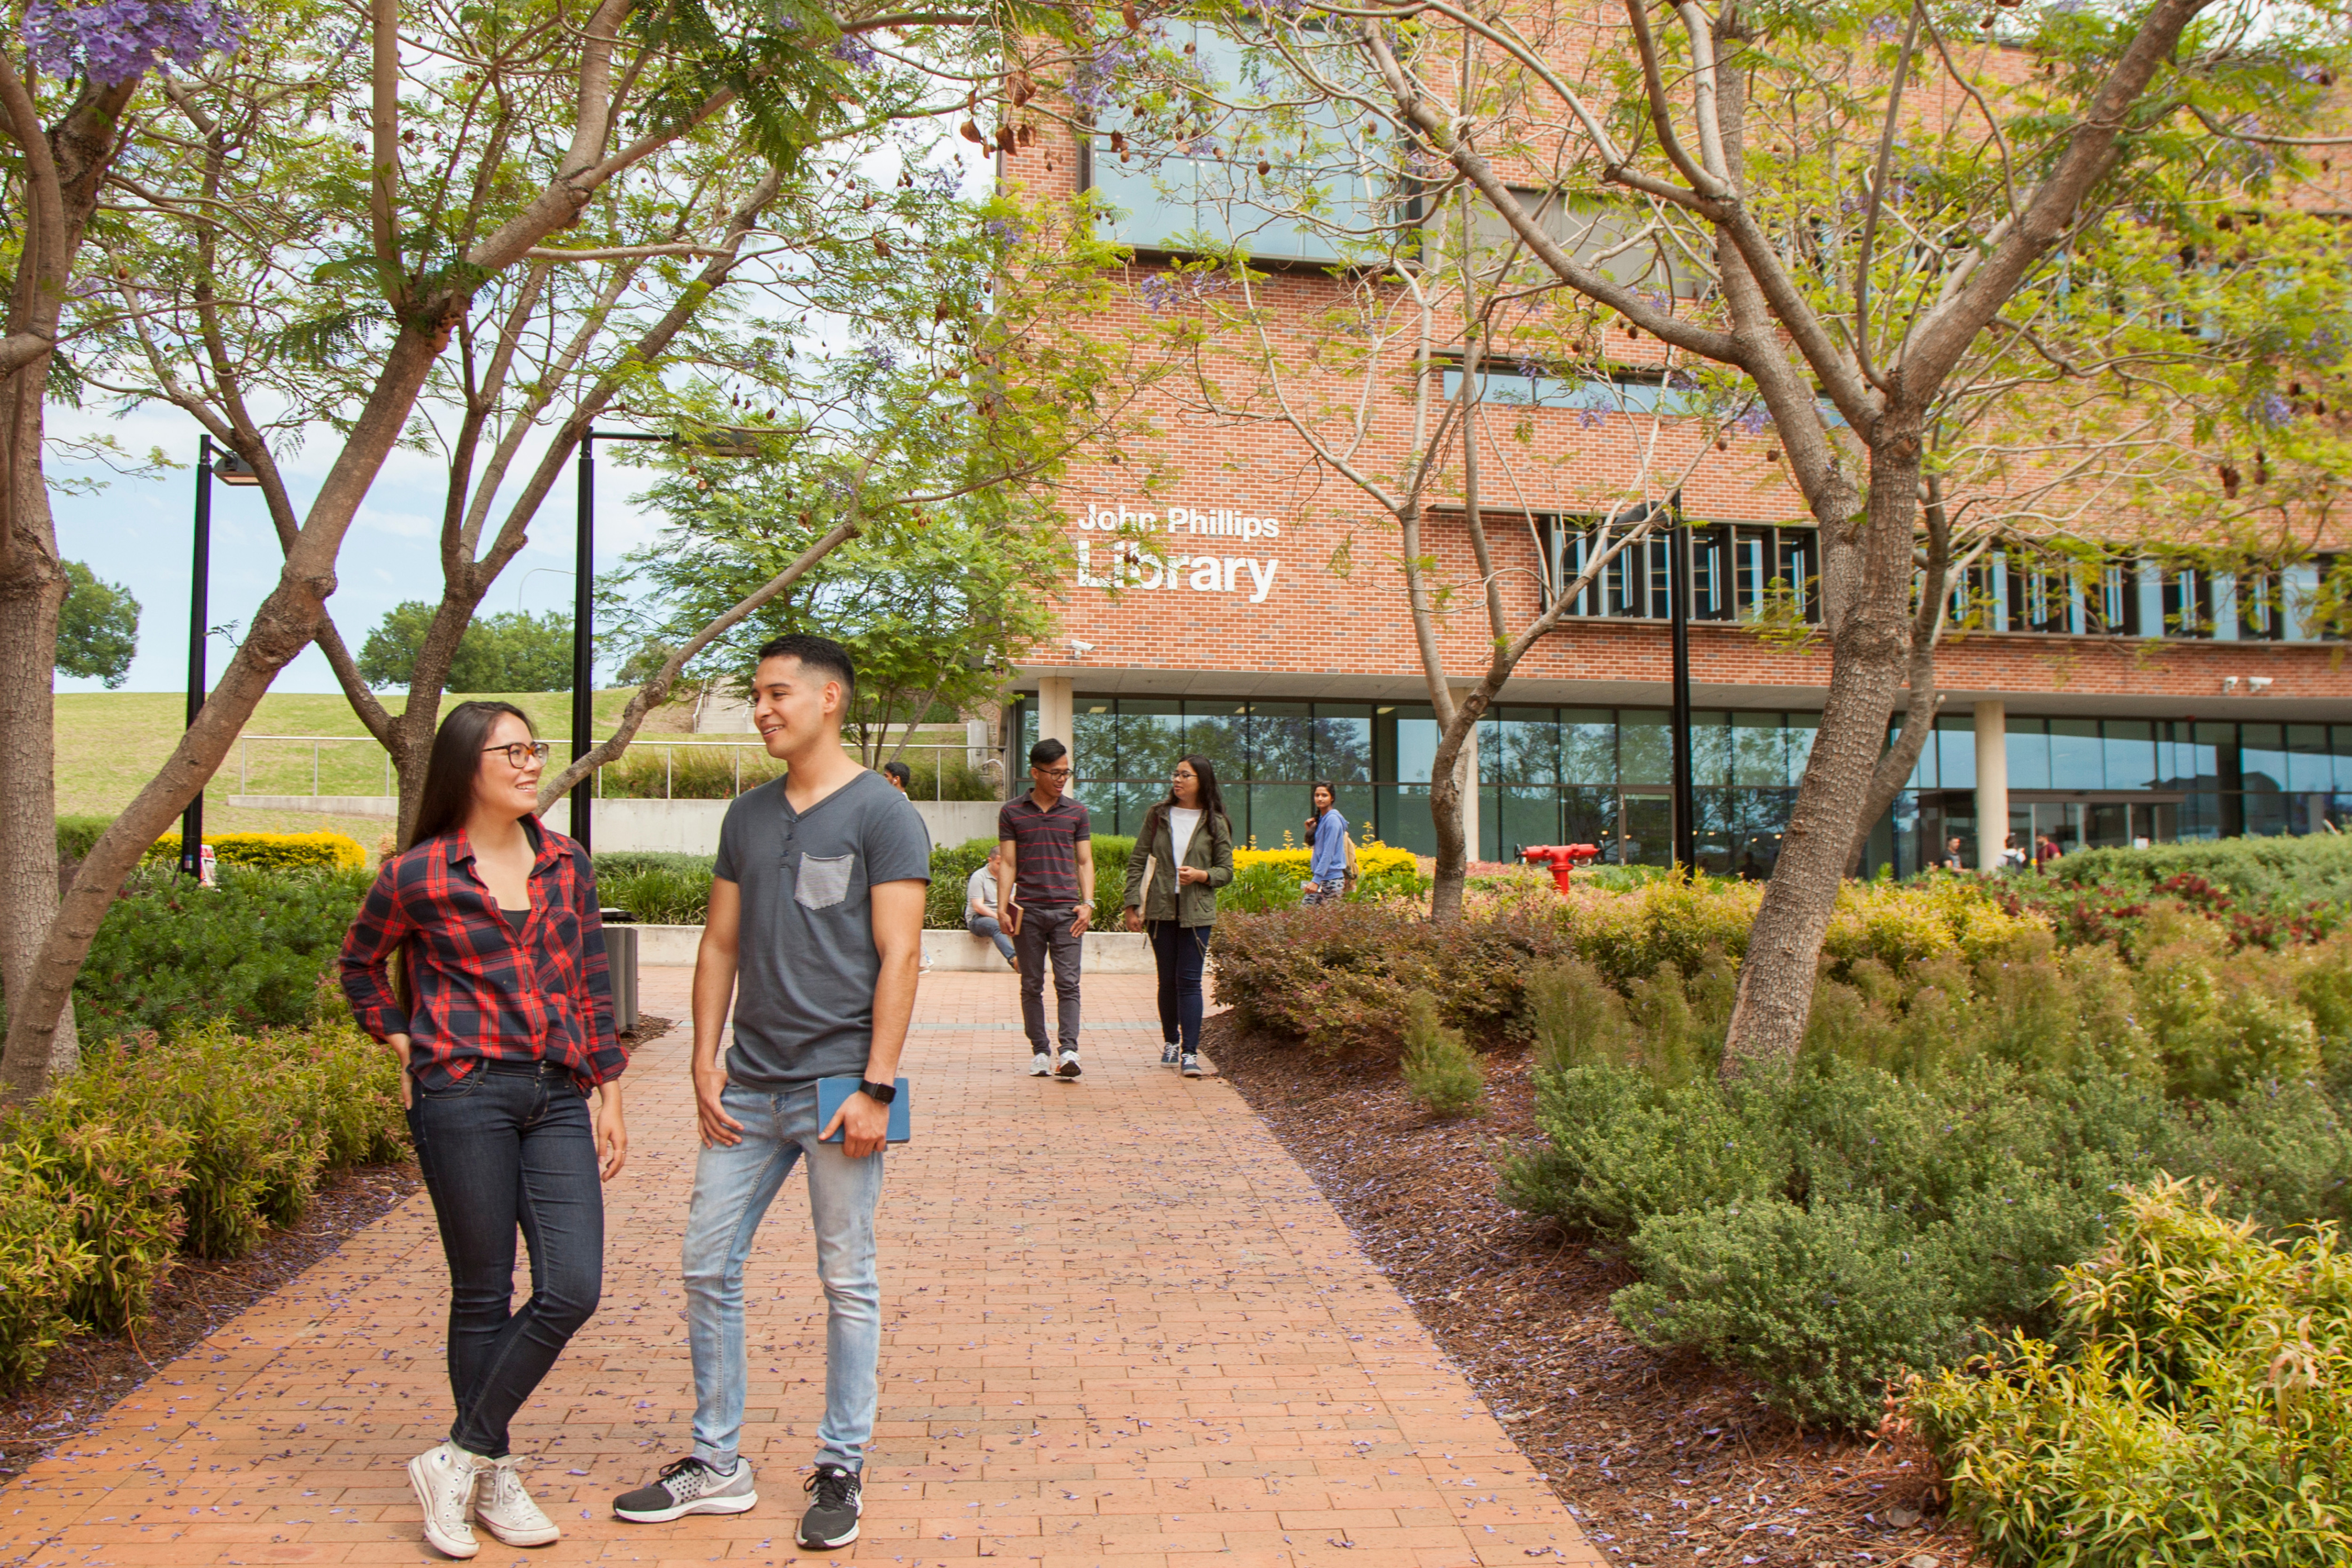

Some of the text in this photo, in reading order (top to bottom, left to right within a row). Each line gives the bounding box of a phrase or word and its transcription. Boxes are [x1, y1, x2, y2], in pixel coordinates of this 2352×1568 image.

[1078, 504, 1279, 542] John Phillips
[1077, 540, 1279, 603] Library
